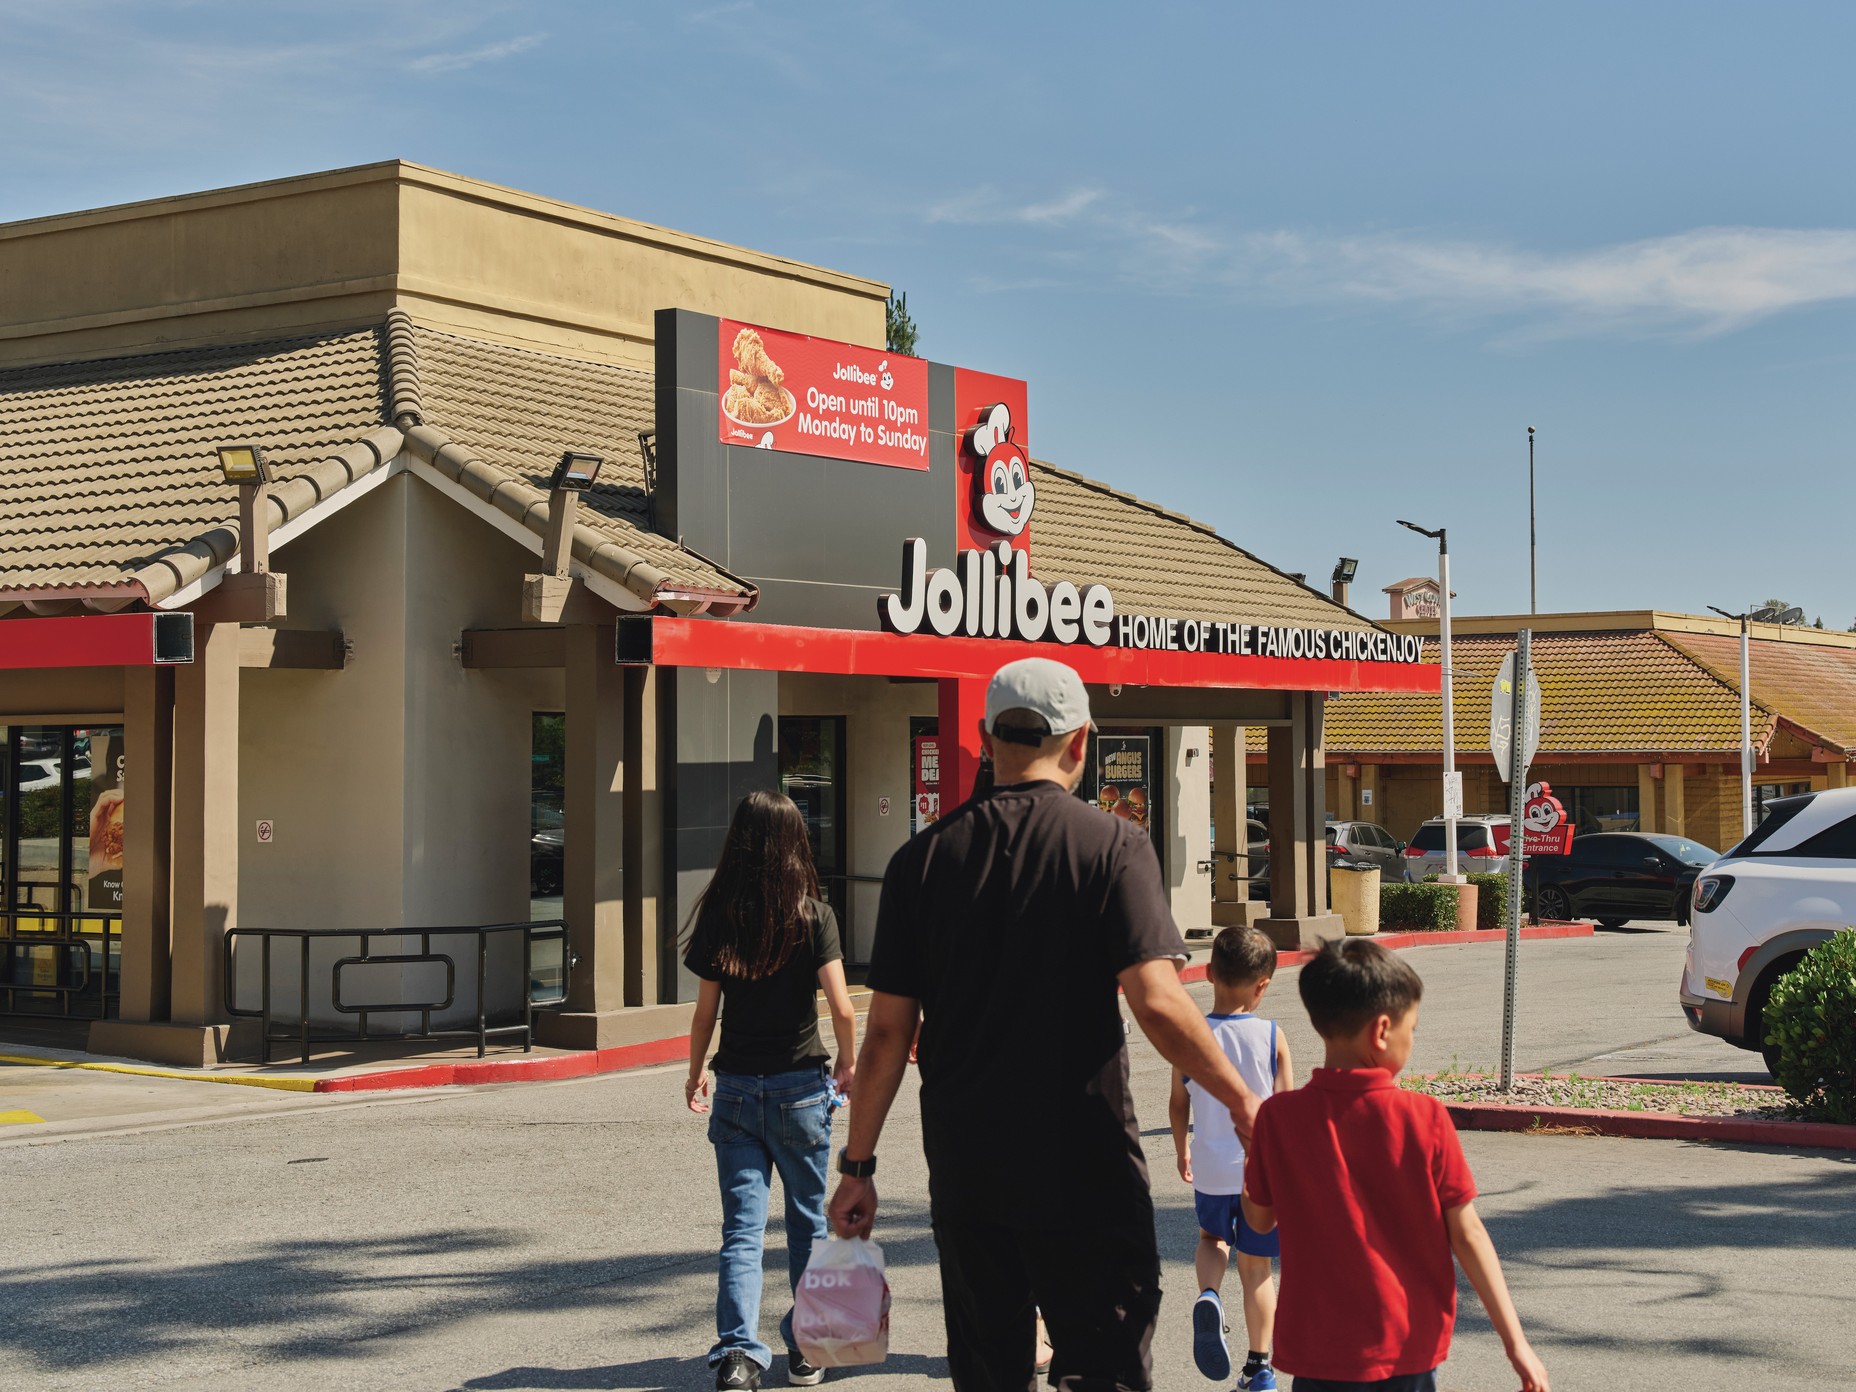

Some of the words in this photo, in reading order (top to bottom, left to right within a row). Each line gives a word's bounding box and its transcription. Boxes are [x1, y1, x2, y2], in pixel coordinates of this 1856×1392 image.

[833, 362, 877, 386] Jollibee
[806, 386, 846, 415] Open
[849, 396, 879, 418] until
[882, 399, 918, 427] 10pm
[797, 412, 857, 446] Monday
[859, 422, 875, 443] to
[877, 425, 927, 456] Sunday
[886, 537, 1114, 646] Jollibee
[1118, 614, 1179, 649] HOME
[1183, 619, 1212, 652] OF
[1215, 622, 1252, 655] THE
[1257, 625, 1327, 659] FAMOUS
[1330, 629, 1425, 664] CHICKENJOY
[921, 755, 939, 768] ME
[1116, 751, 1142, 765] ANGUS
[1105, 764, 1143, 779] BURGERS
[103, 880, 121, 889] Know
[112, 890, 124, 902] Kn
[805, 1271, 850, 1289] bok
